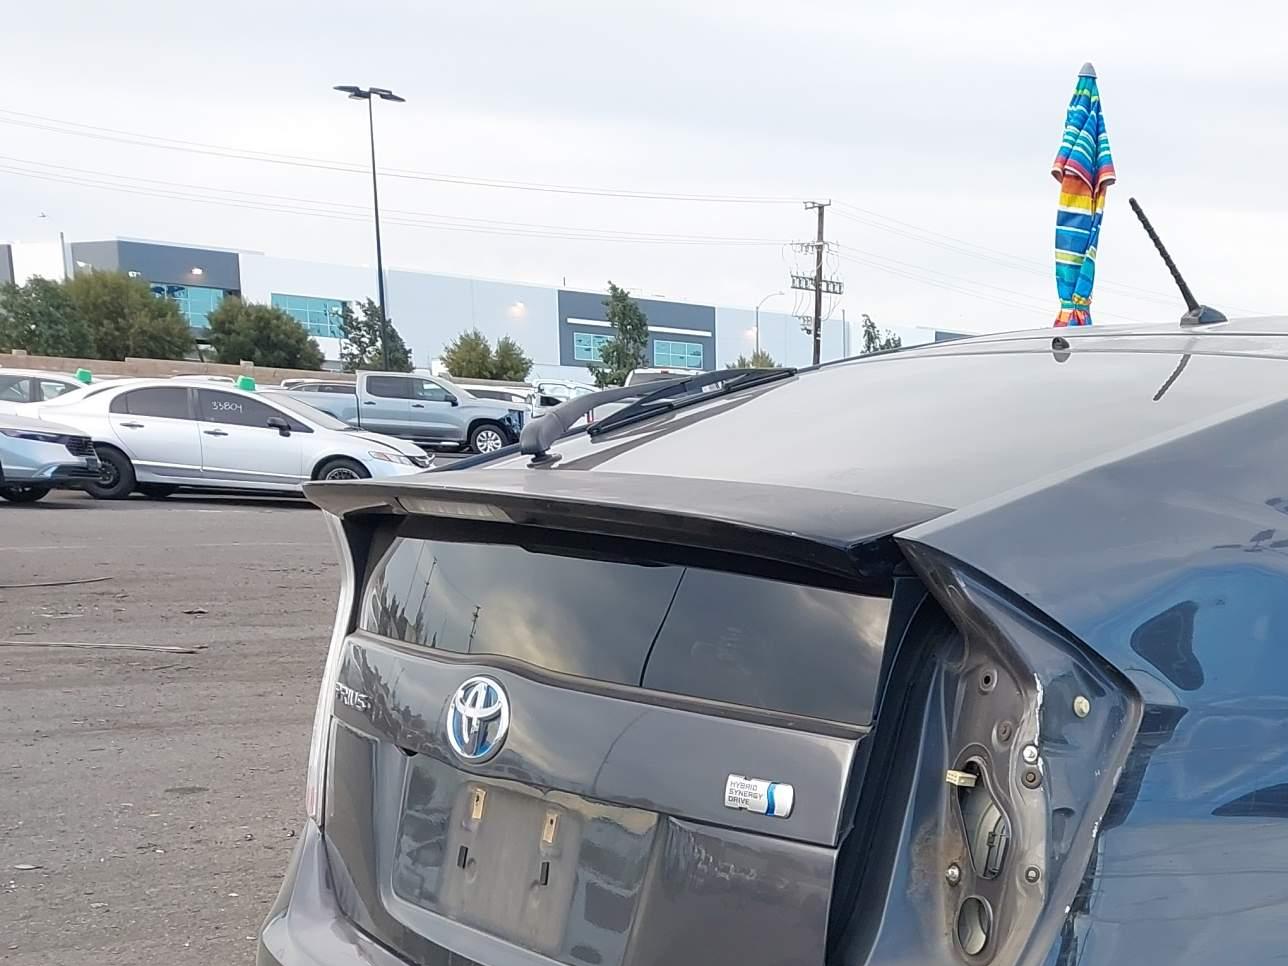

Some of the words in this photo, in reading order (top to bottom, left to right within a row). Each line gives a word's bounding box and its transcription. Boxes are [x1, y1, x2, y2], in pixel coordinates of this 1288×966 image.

[730, 781, 759, 792] HYBRID
[728, 788, 764, 801] SYNERGY
[727, 795, 751, 806] DRIVE
